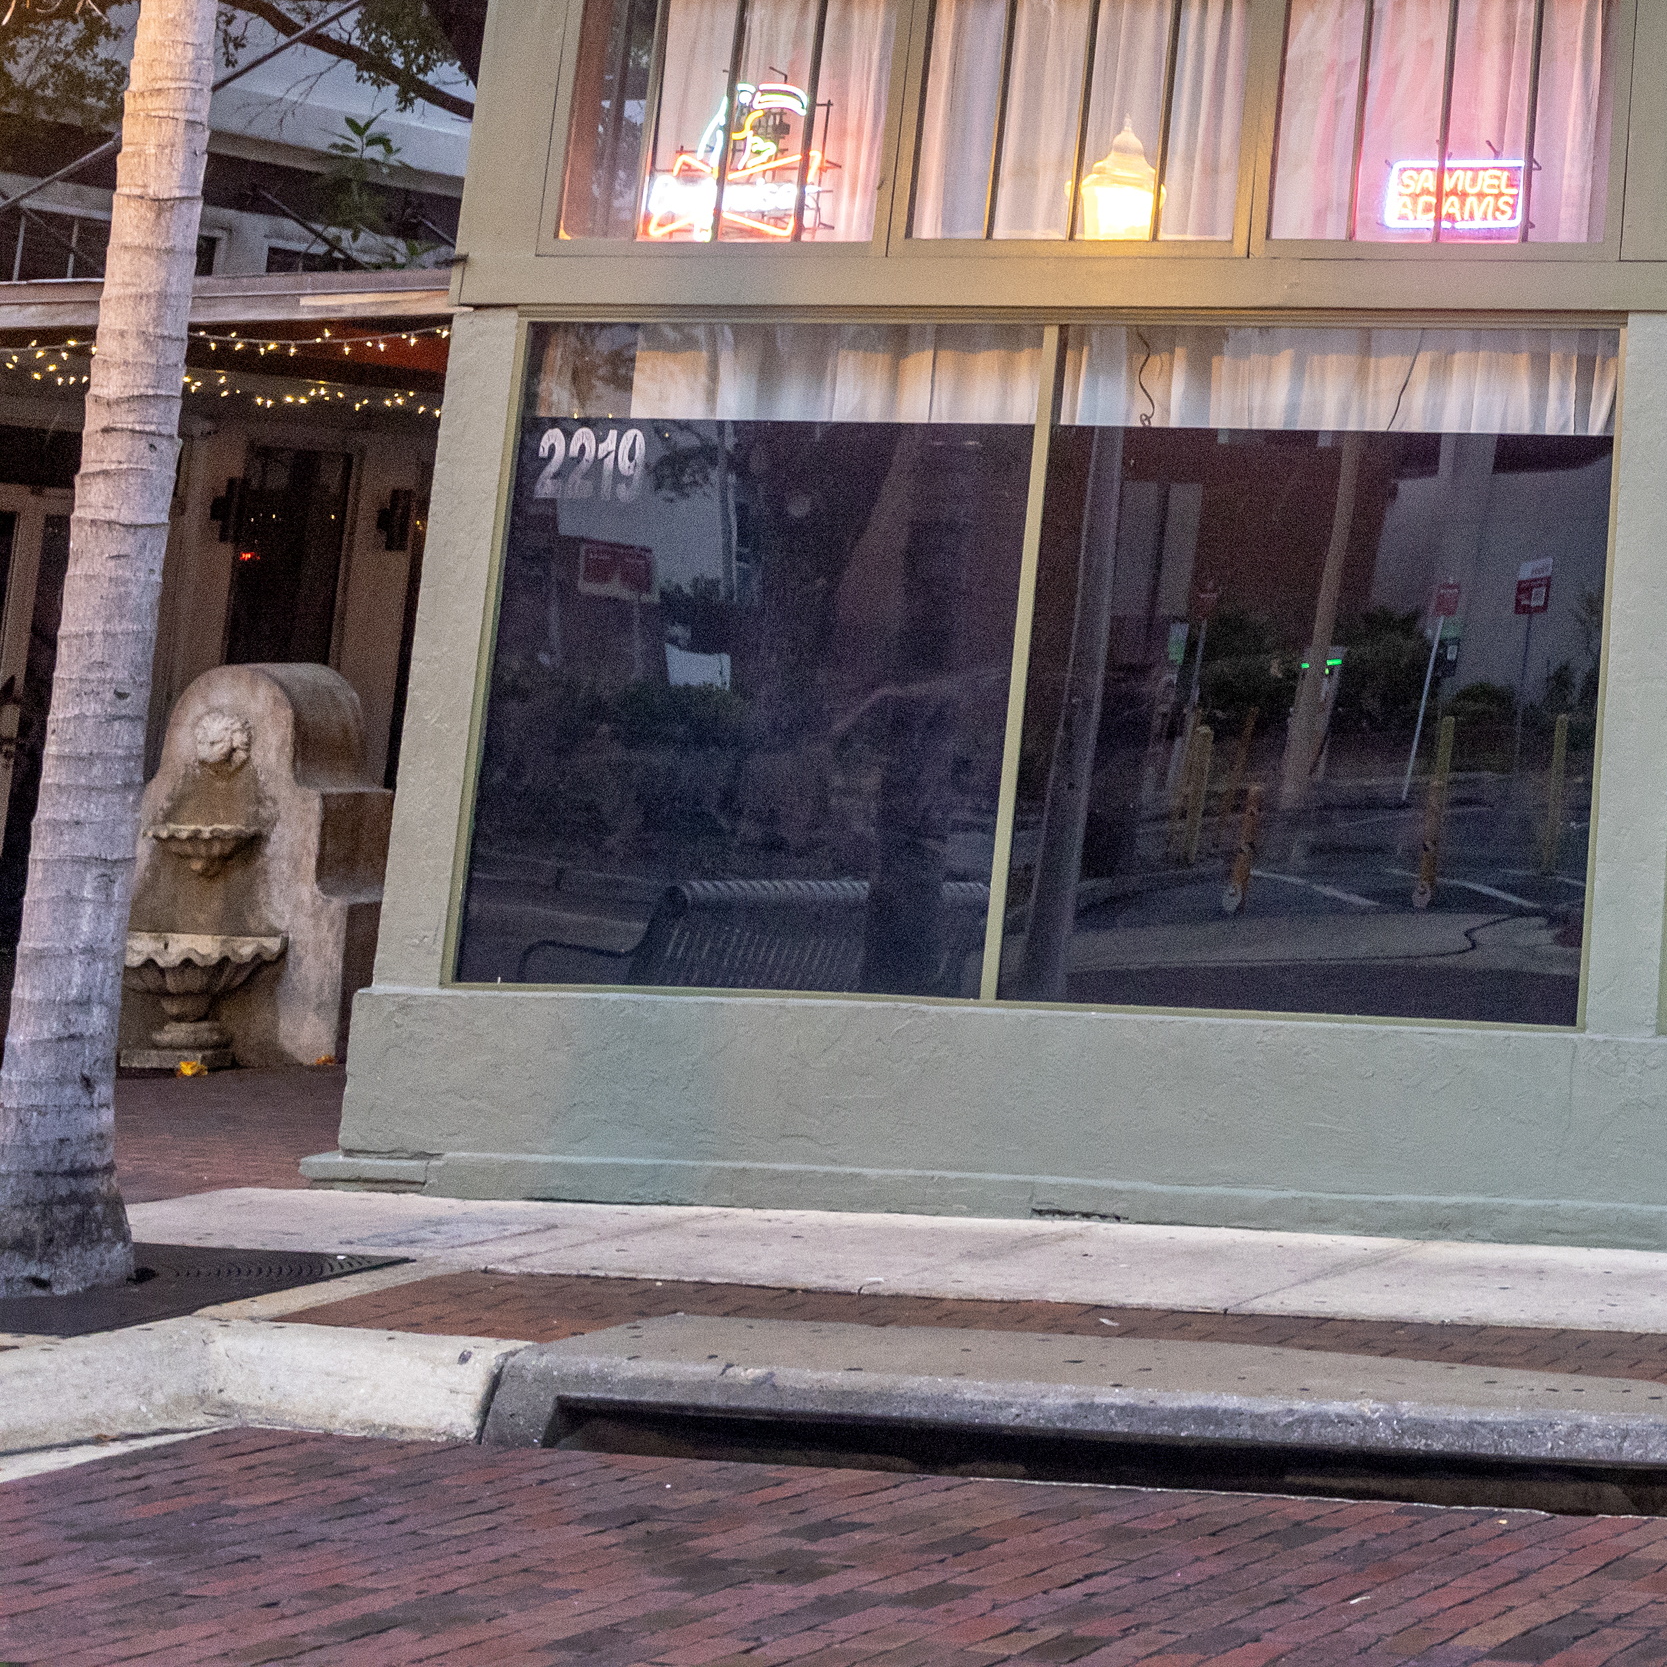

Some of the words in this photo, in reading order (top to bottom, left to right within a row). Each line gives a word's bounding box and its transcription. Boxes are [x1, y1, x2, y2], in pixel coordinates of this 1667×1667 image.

[1398, 170, 1519, 195] SAMUEL
[1396, 195, 1515, 221] ADAMS
[534, 427, 646, 503] 2219
